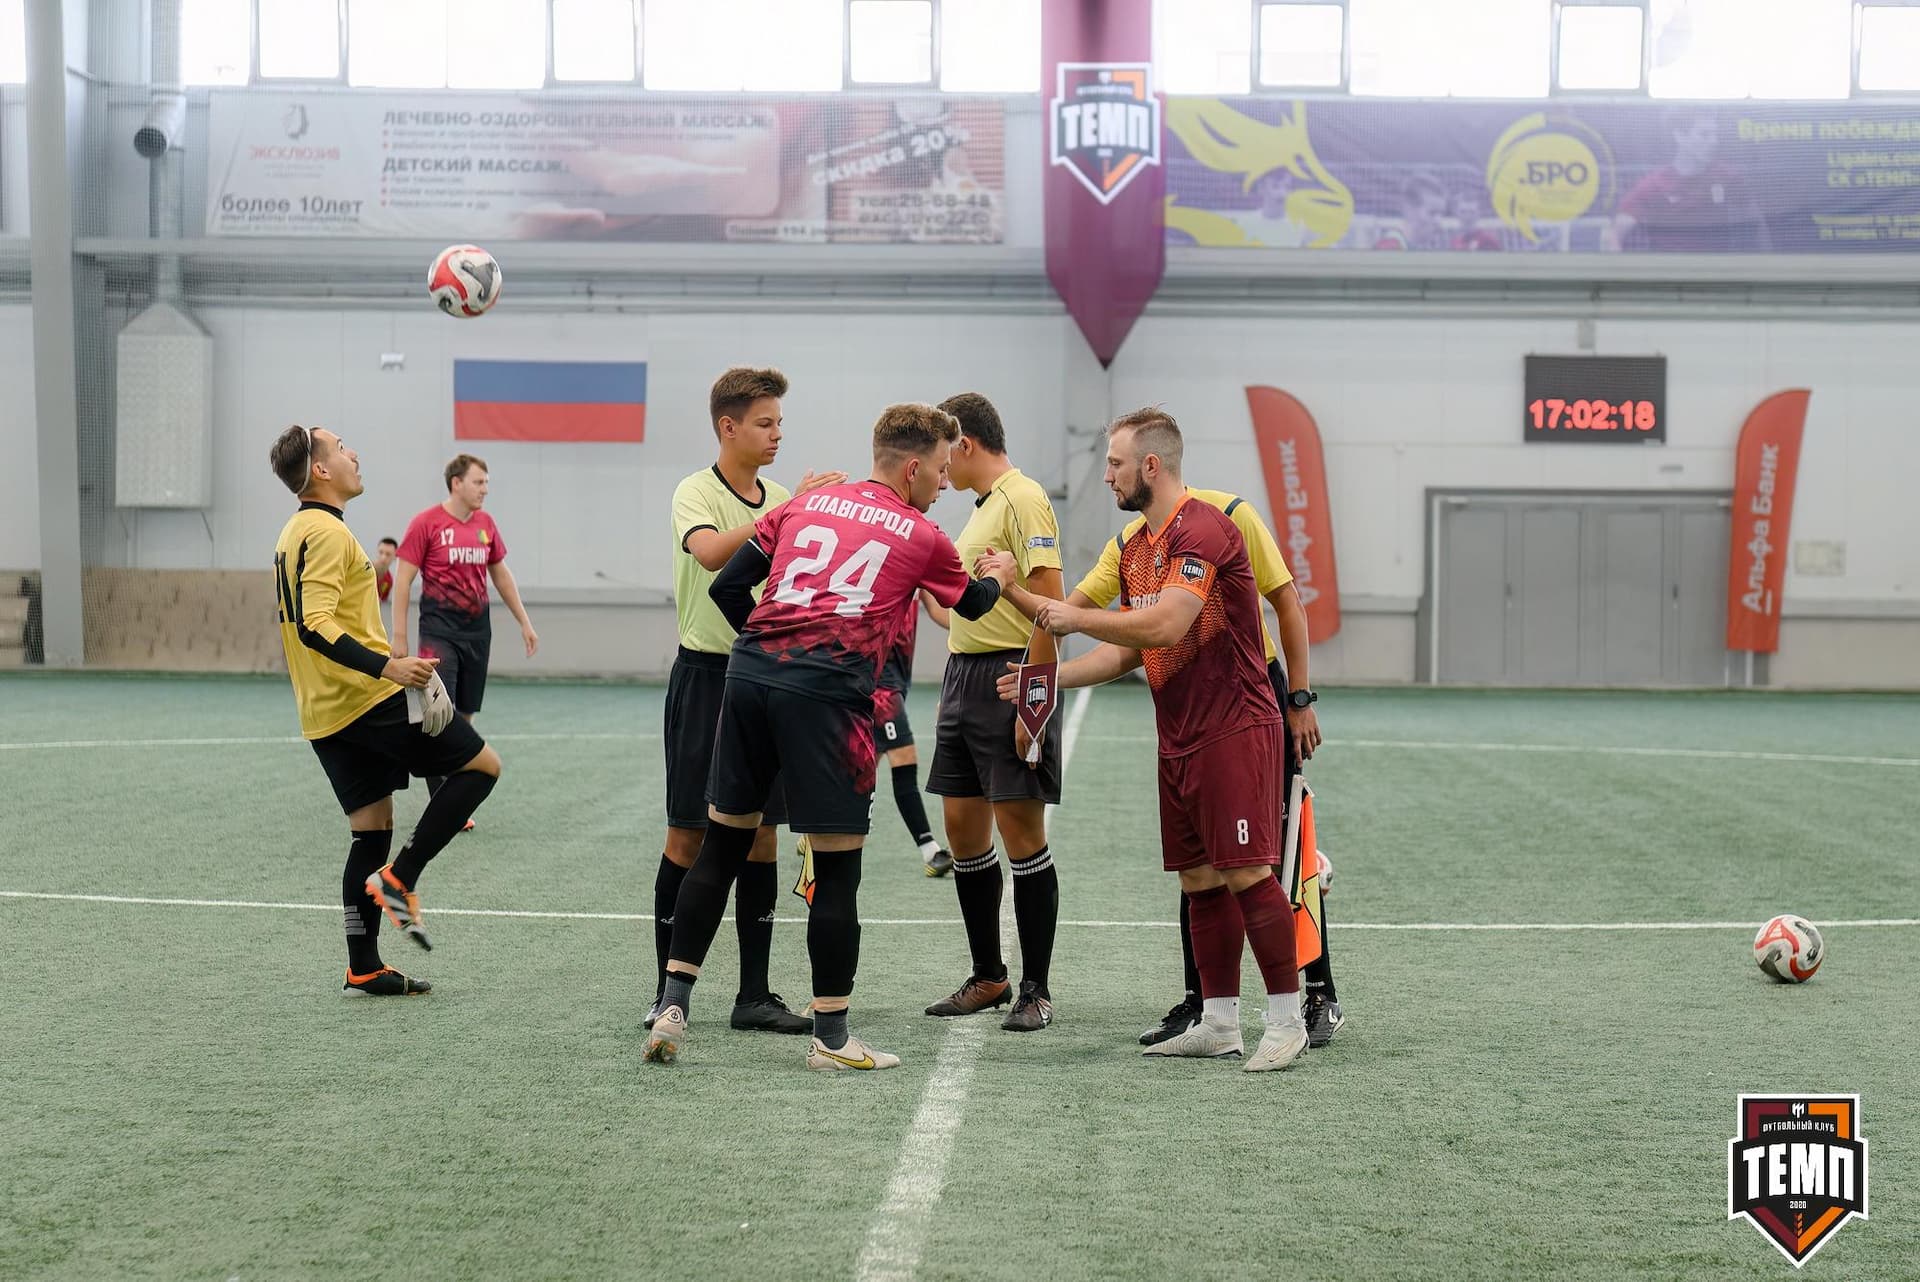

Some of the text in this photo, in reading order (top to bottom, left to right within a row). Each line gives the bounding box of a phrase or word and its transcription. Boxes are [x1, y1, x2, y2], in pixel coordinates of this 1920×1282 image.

[1061, 101, 1150, 150] ТЕМП
[1738, 120, 1813, 142] Время
[250, 145, 340, 160] ЭКСКЛЮЗИВ
[910, 125, 970, 159] 20%
[383, 153, 473, 174] ДЕТСКИЙ
[221, 195, 363, 214] более 10лет
[1529, 398, 1656, 431] 17:02:18
[1277, 437, 1308, 510] Банк
[805, 494, 916, 541] СЛАВГОРОД
[1741, 442, 1778, 616] Альфа Банк
[441, 528, 455, 545] 17
[772, 524, 891, 618] 24
[1182, 563, 1204, 578] ТЕМП
[884, 721, 897, 741] 8
[1236, 818, 1249, 845] 8
